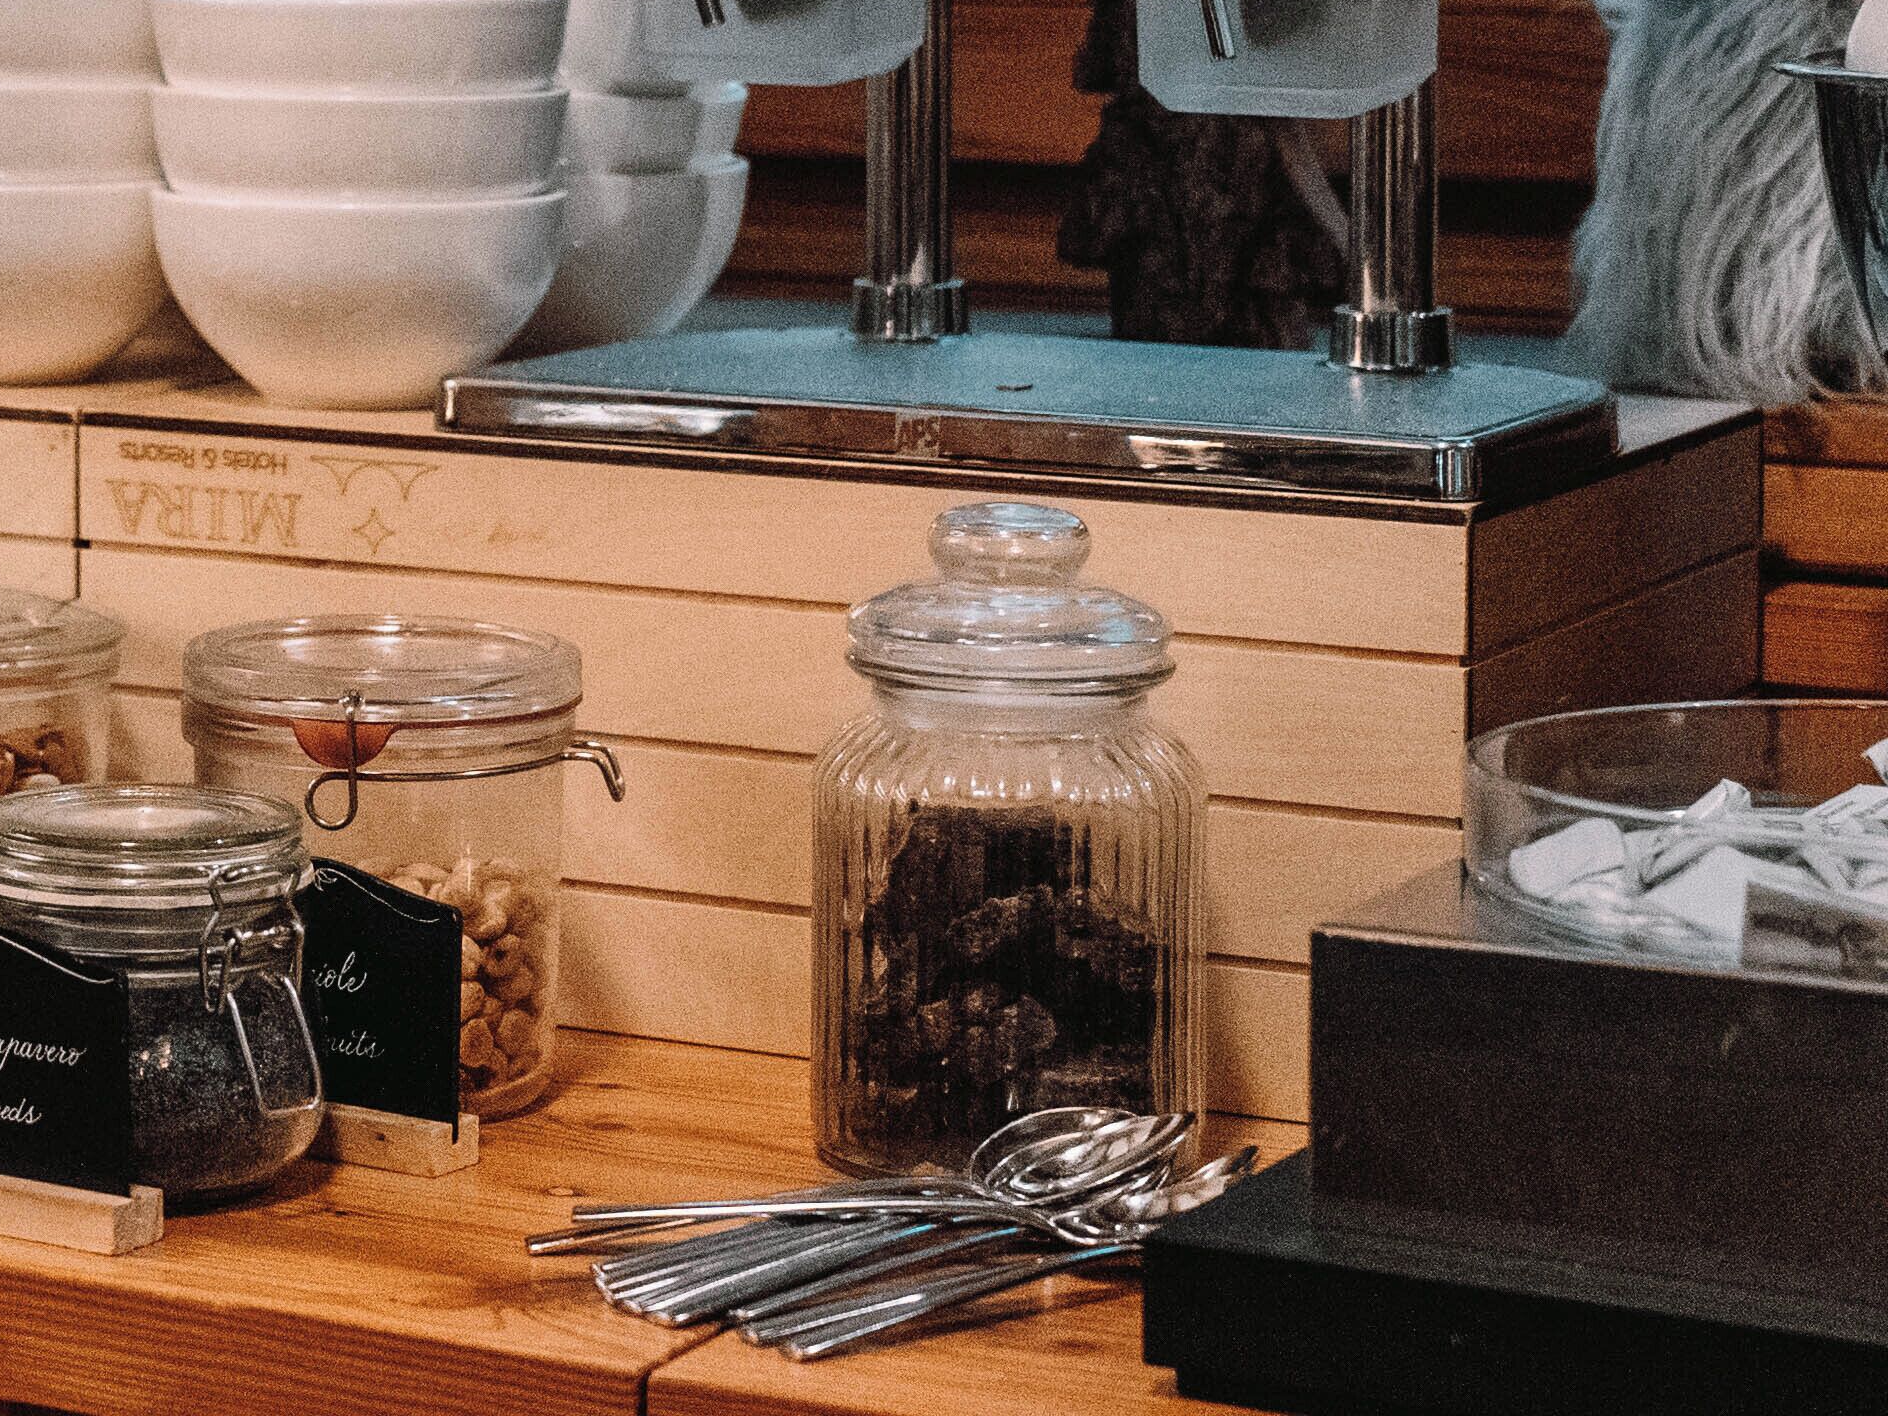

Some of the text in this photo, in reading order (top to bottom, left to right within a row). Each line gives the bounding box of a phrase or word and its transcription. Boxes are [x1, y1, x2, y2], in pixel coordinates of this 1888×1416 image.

[119, 441, 289, 475] Hotels & Resorts
[104, 478, 302, 547] MIRA
